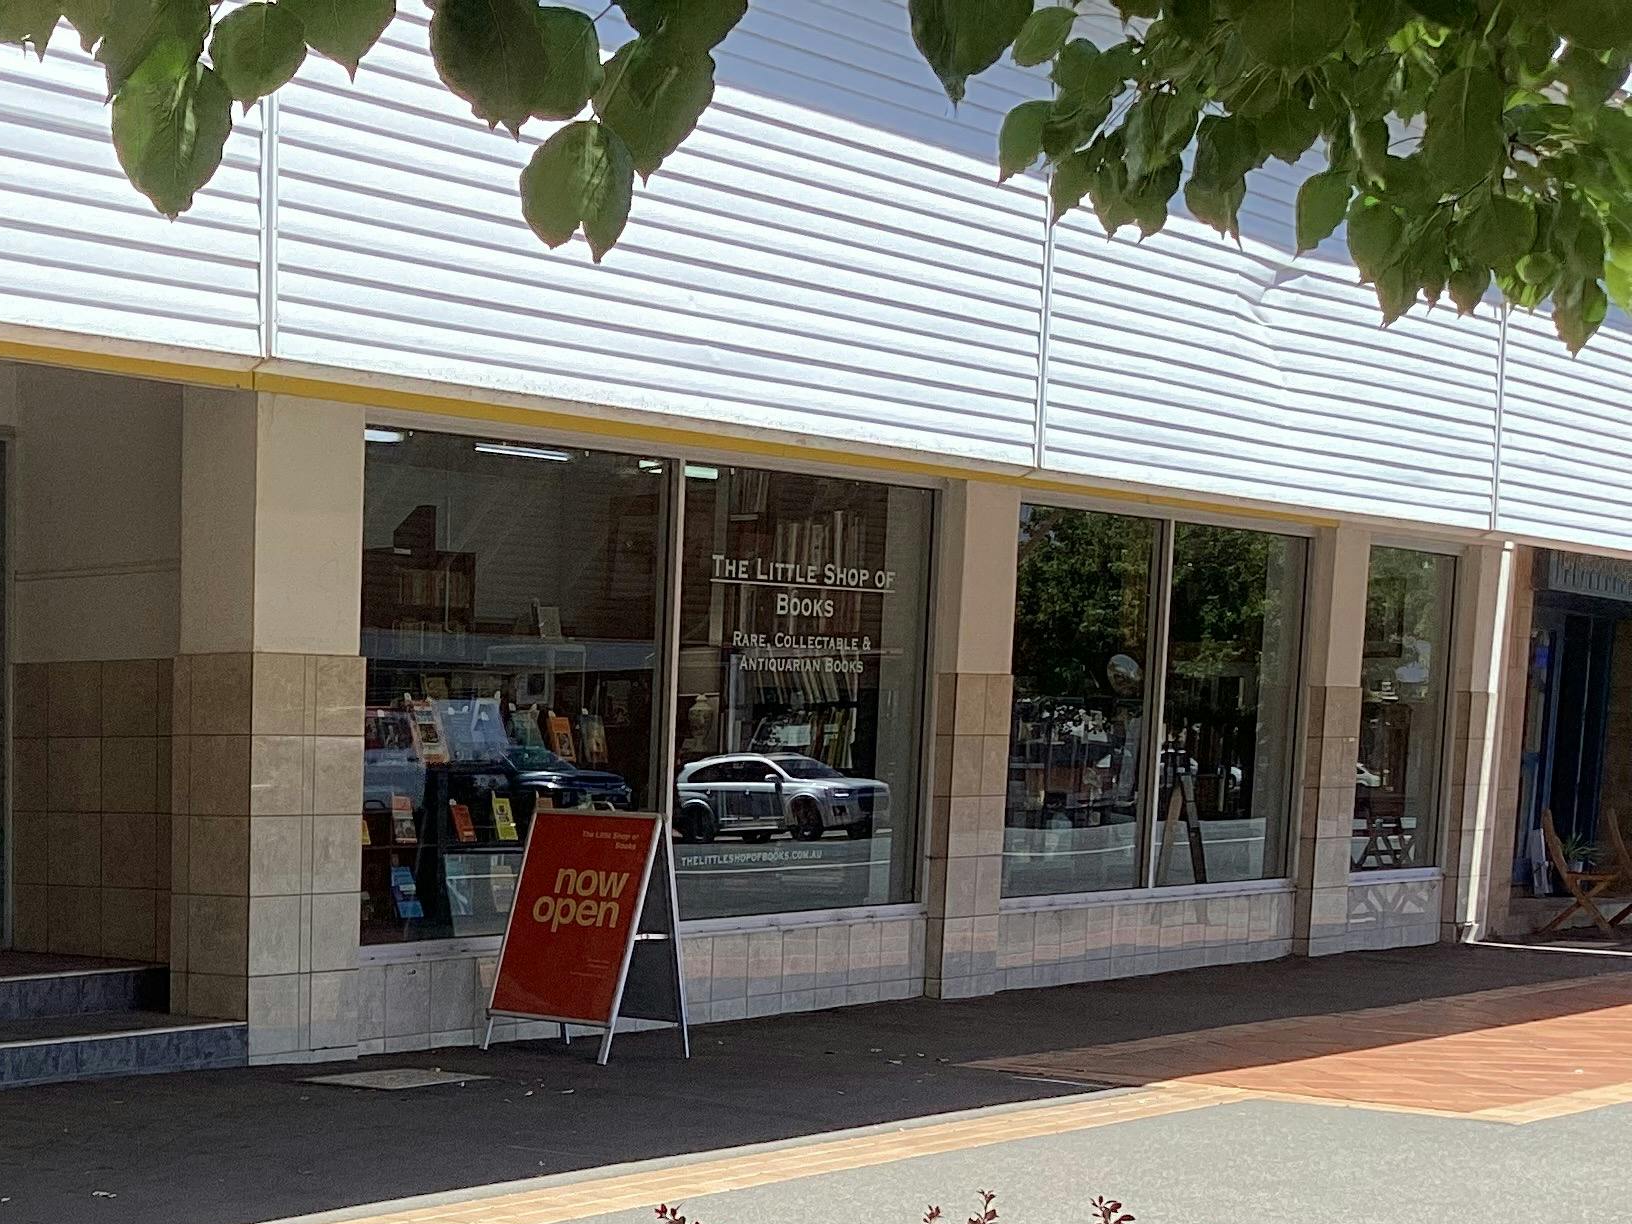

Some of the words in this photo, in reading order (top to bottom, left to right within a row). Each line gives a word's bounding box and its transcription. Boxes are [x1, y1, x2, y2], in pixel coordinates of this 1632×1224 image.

[712, 554, 749, 579] THE
[756, 558, 817, 584] LITTLE
[824, 563, 869, 588] SHOP
[874, 570, 896, 589] OF
[776, 593, 834, 618] BOOKS
[732, 630, 772, 649] RARE,
[774, 632, 859, 650] COLLECTABLE
[862, 636, 871, 651] &
[739, 655, 821, 672] ANTIQUARIAN
[824, 657, 864, 673] BOOKS
[554, 868, 630, 898] now
[532, 895, 620, 933] open
